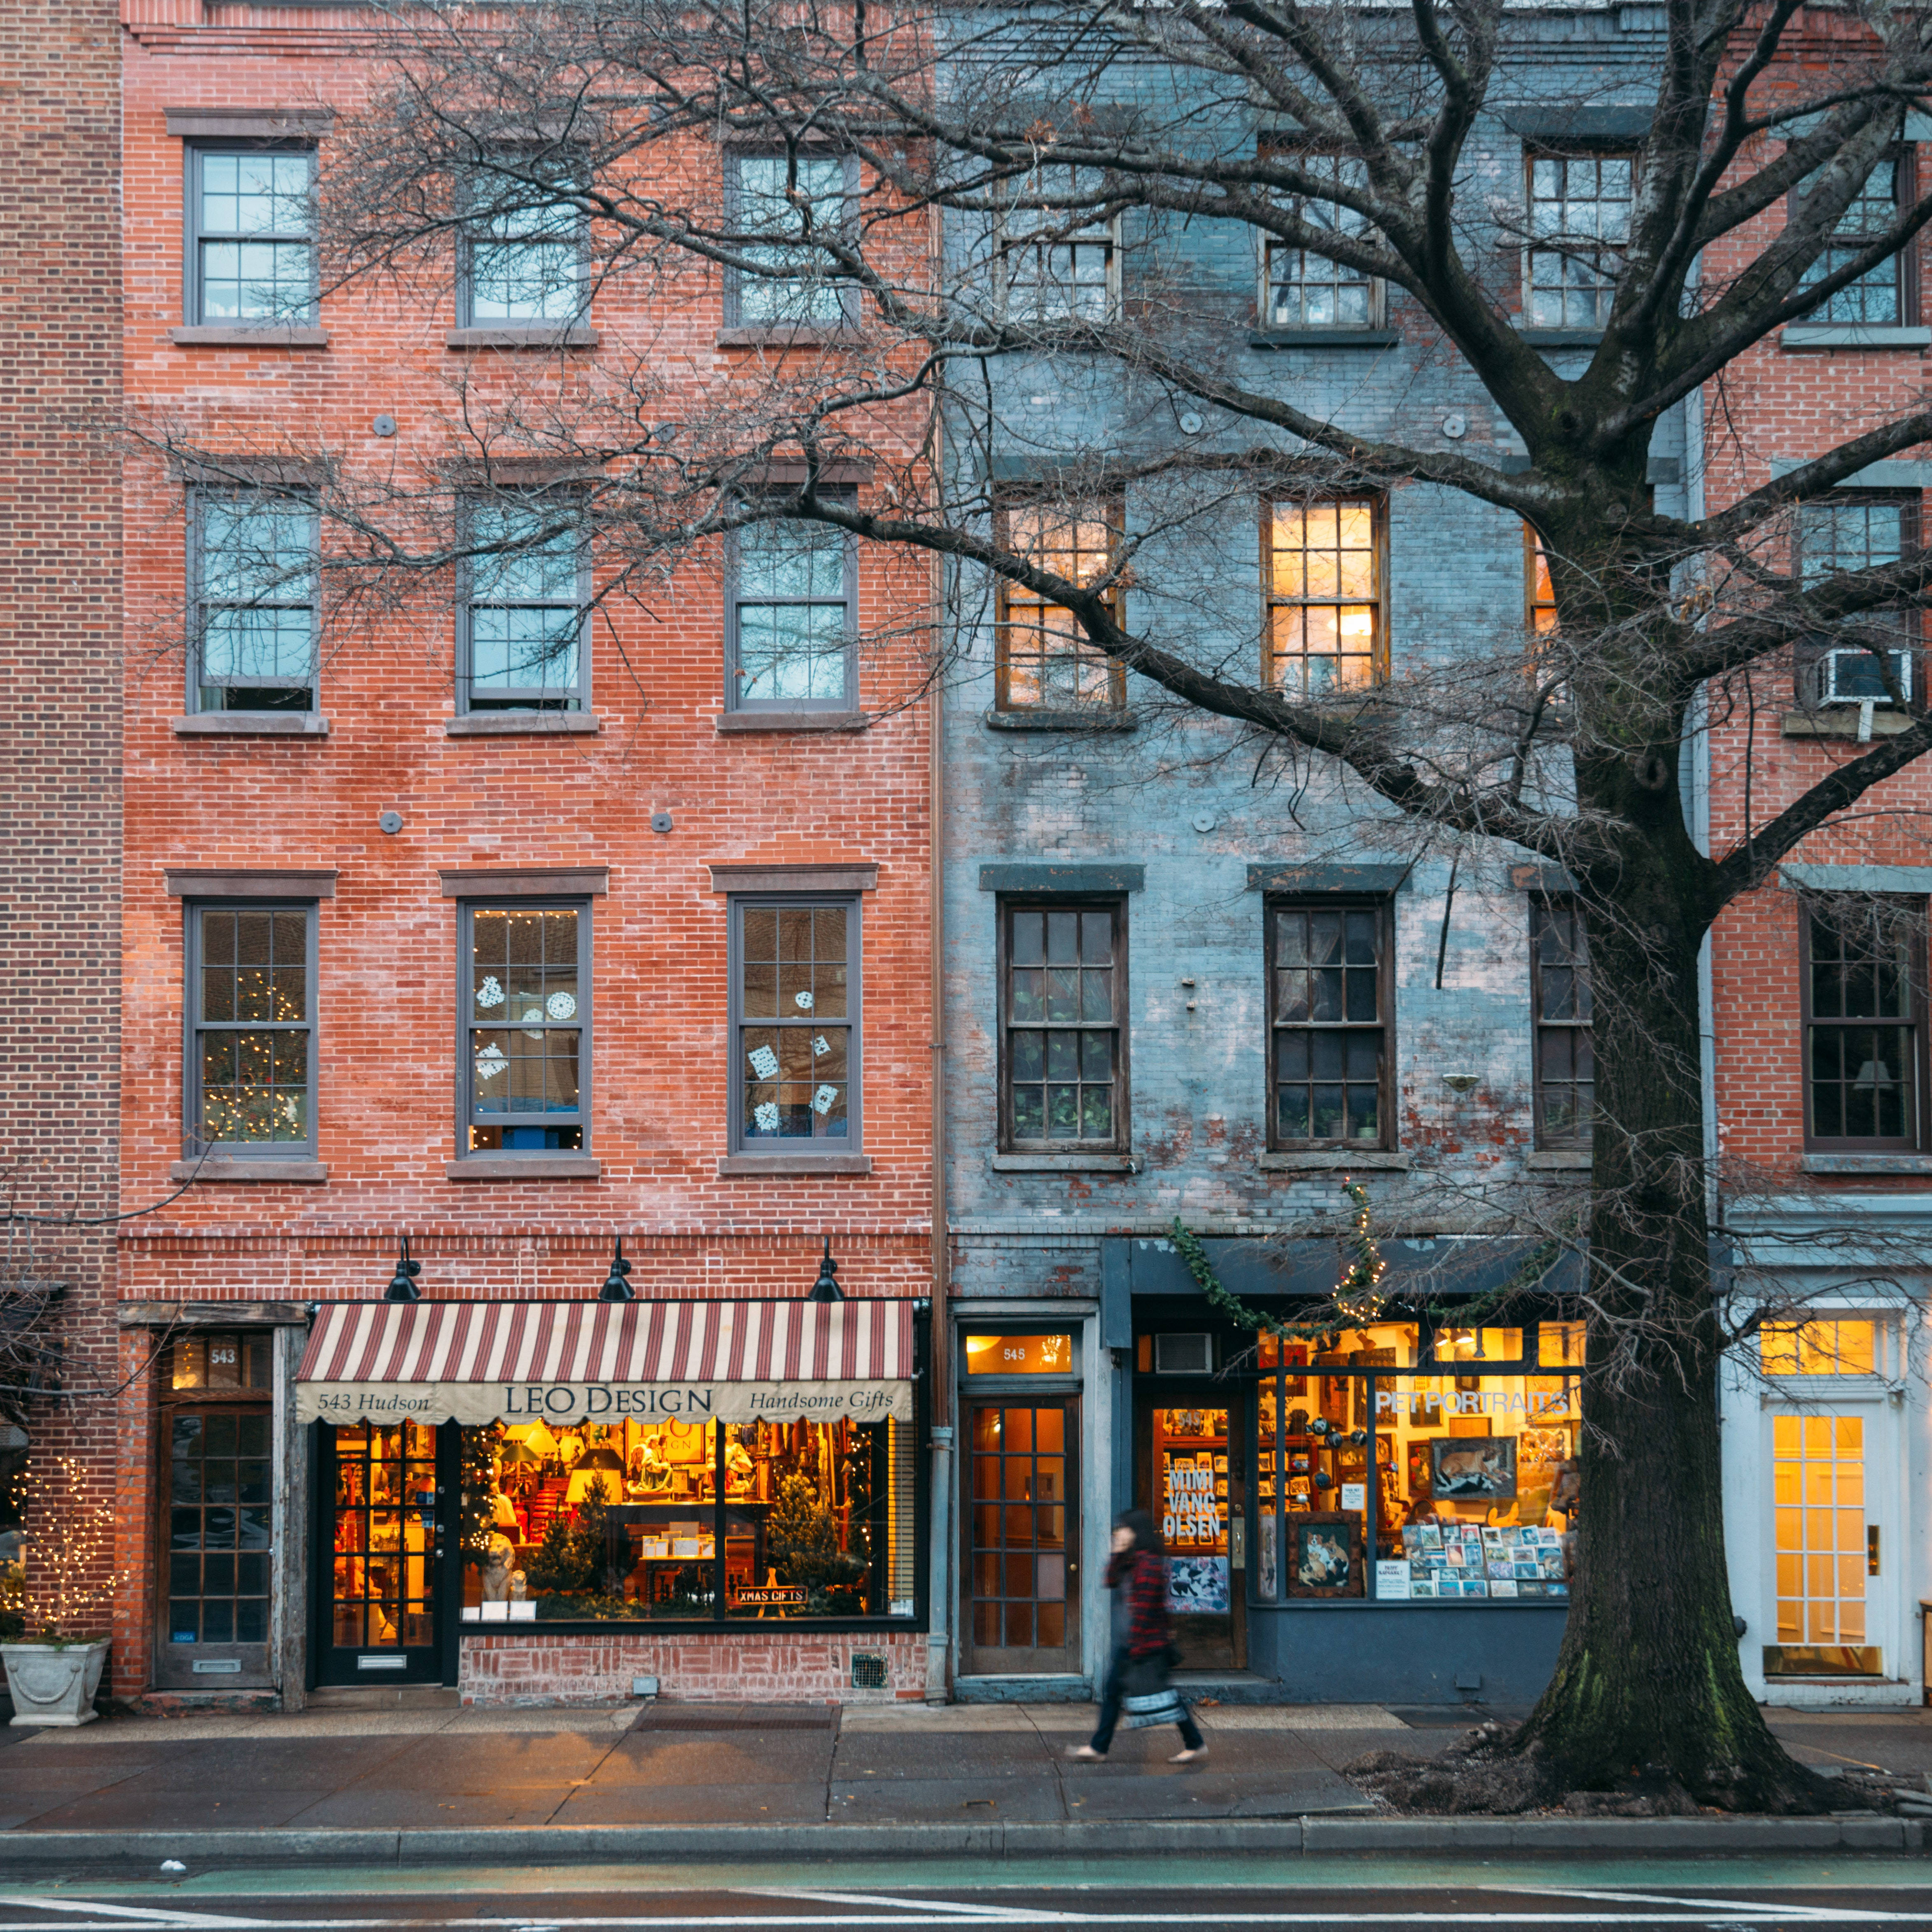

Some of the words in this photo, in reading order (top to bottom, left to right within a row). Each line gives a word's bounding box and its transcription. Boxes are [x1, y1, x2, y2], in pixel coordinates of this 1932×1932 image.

[212, 1349, 235, 1363] 543
[1004, 1348, 1025, 1360] 545
[318, 1394, 351, 1409] 543
[358, 1394, 429, 1410] Hudson
[504, 1387, 575, 1413] LEO
[585, 1387, 713, 1413] DESIGN
[750, 1392, 843, 1408] Handsome
[849, 1391, 894, 1412] Gifts
[1375, 1391, 1421, 1414] PET
[1425, 1391, 1569, 1414] PORTRAITS
[1179, 1412, 1200, 1426] 545
[1169, 1469, 1213, 1490] MIMI
[1169, 1491, 1215, 1513] VANG
[1163, 1514, 1220, 1537] OLSEN
[740, 1590, 768, 1601] XMAS
[772, 1590, 803, 1601] GIFTS
